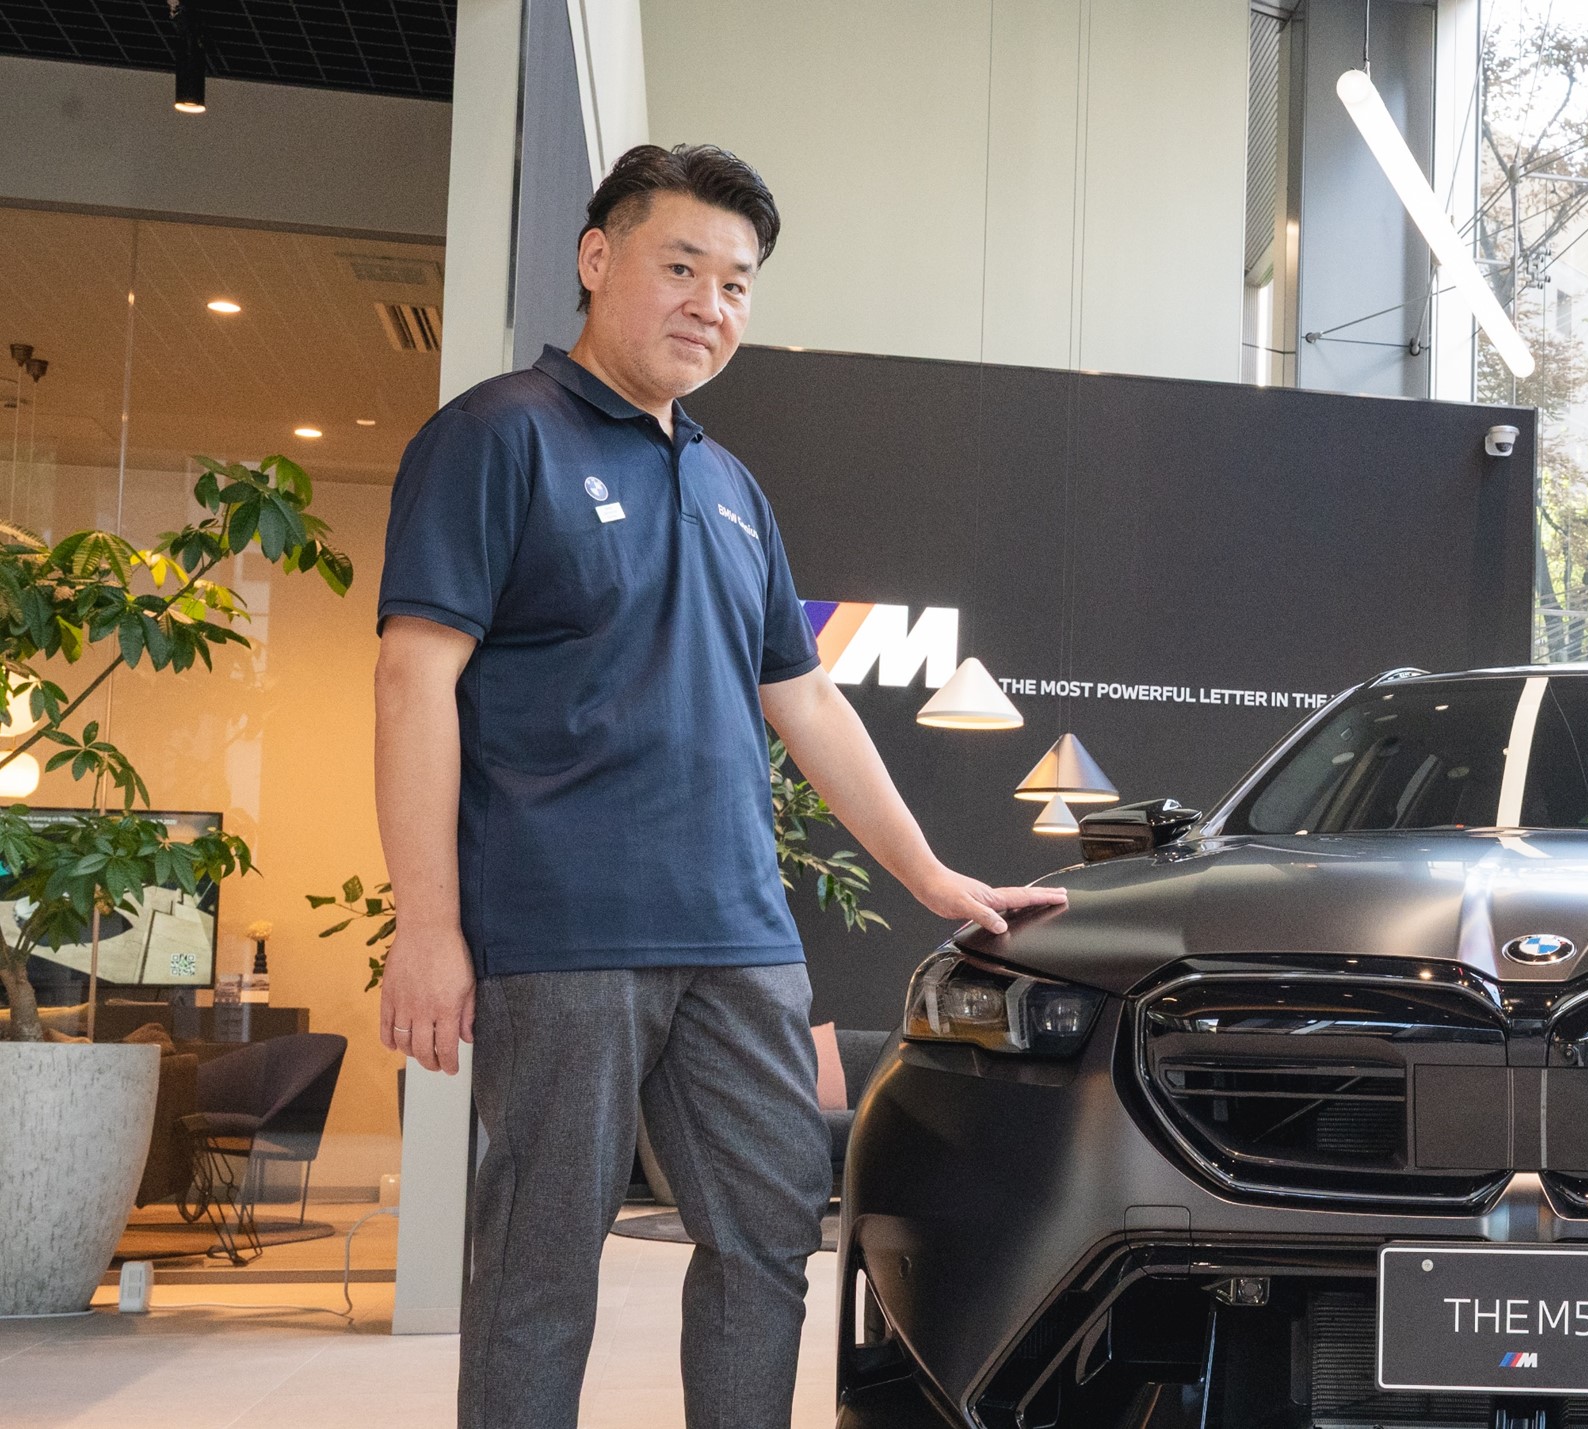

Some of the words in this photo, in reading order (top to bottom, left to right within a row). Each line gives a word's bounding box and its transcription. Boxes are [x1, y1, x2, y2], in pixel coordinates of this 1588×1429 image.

[717, 503, 738, 524] BMW
[999, 677, 1037, 696] THE
[1040, 681, 1094, 698] MOST
[1097, 683, 1197, 702] POWERFUL
[1200, 689, 1268, 707] LETTER
[1271, 691, 1289, 708] IN
[1291, 693, 1328, 709] THE
[1443, 1298, 1530, 1334] THE
